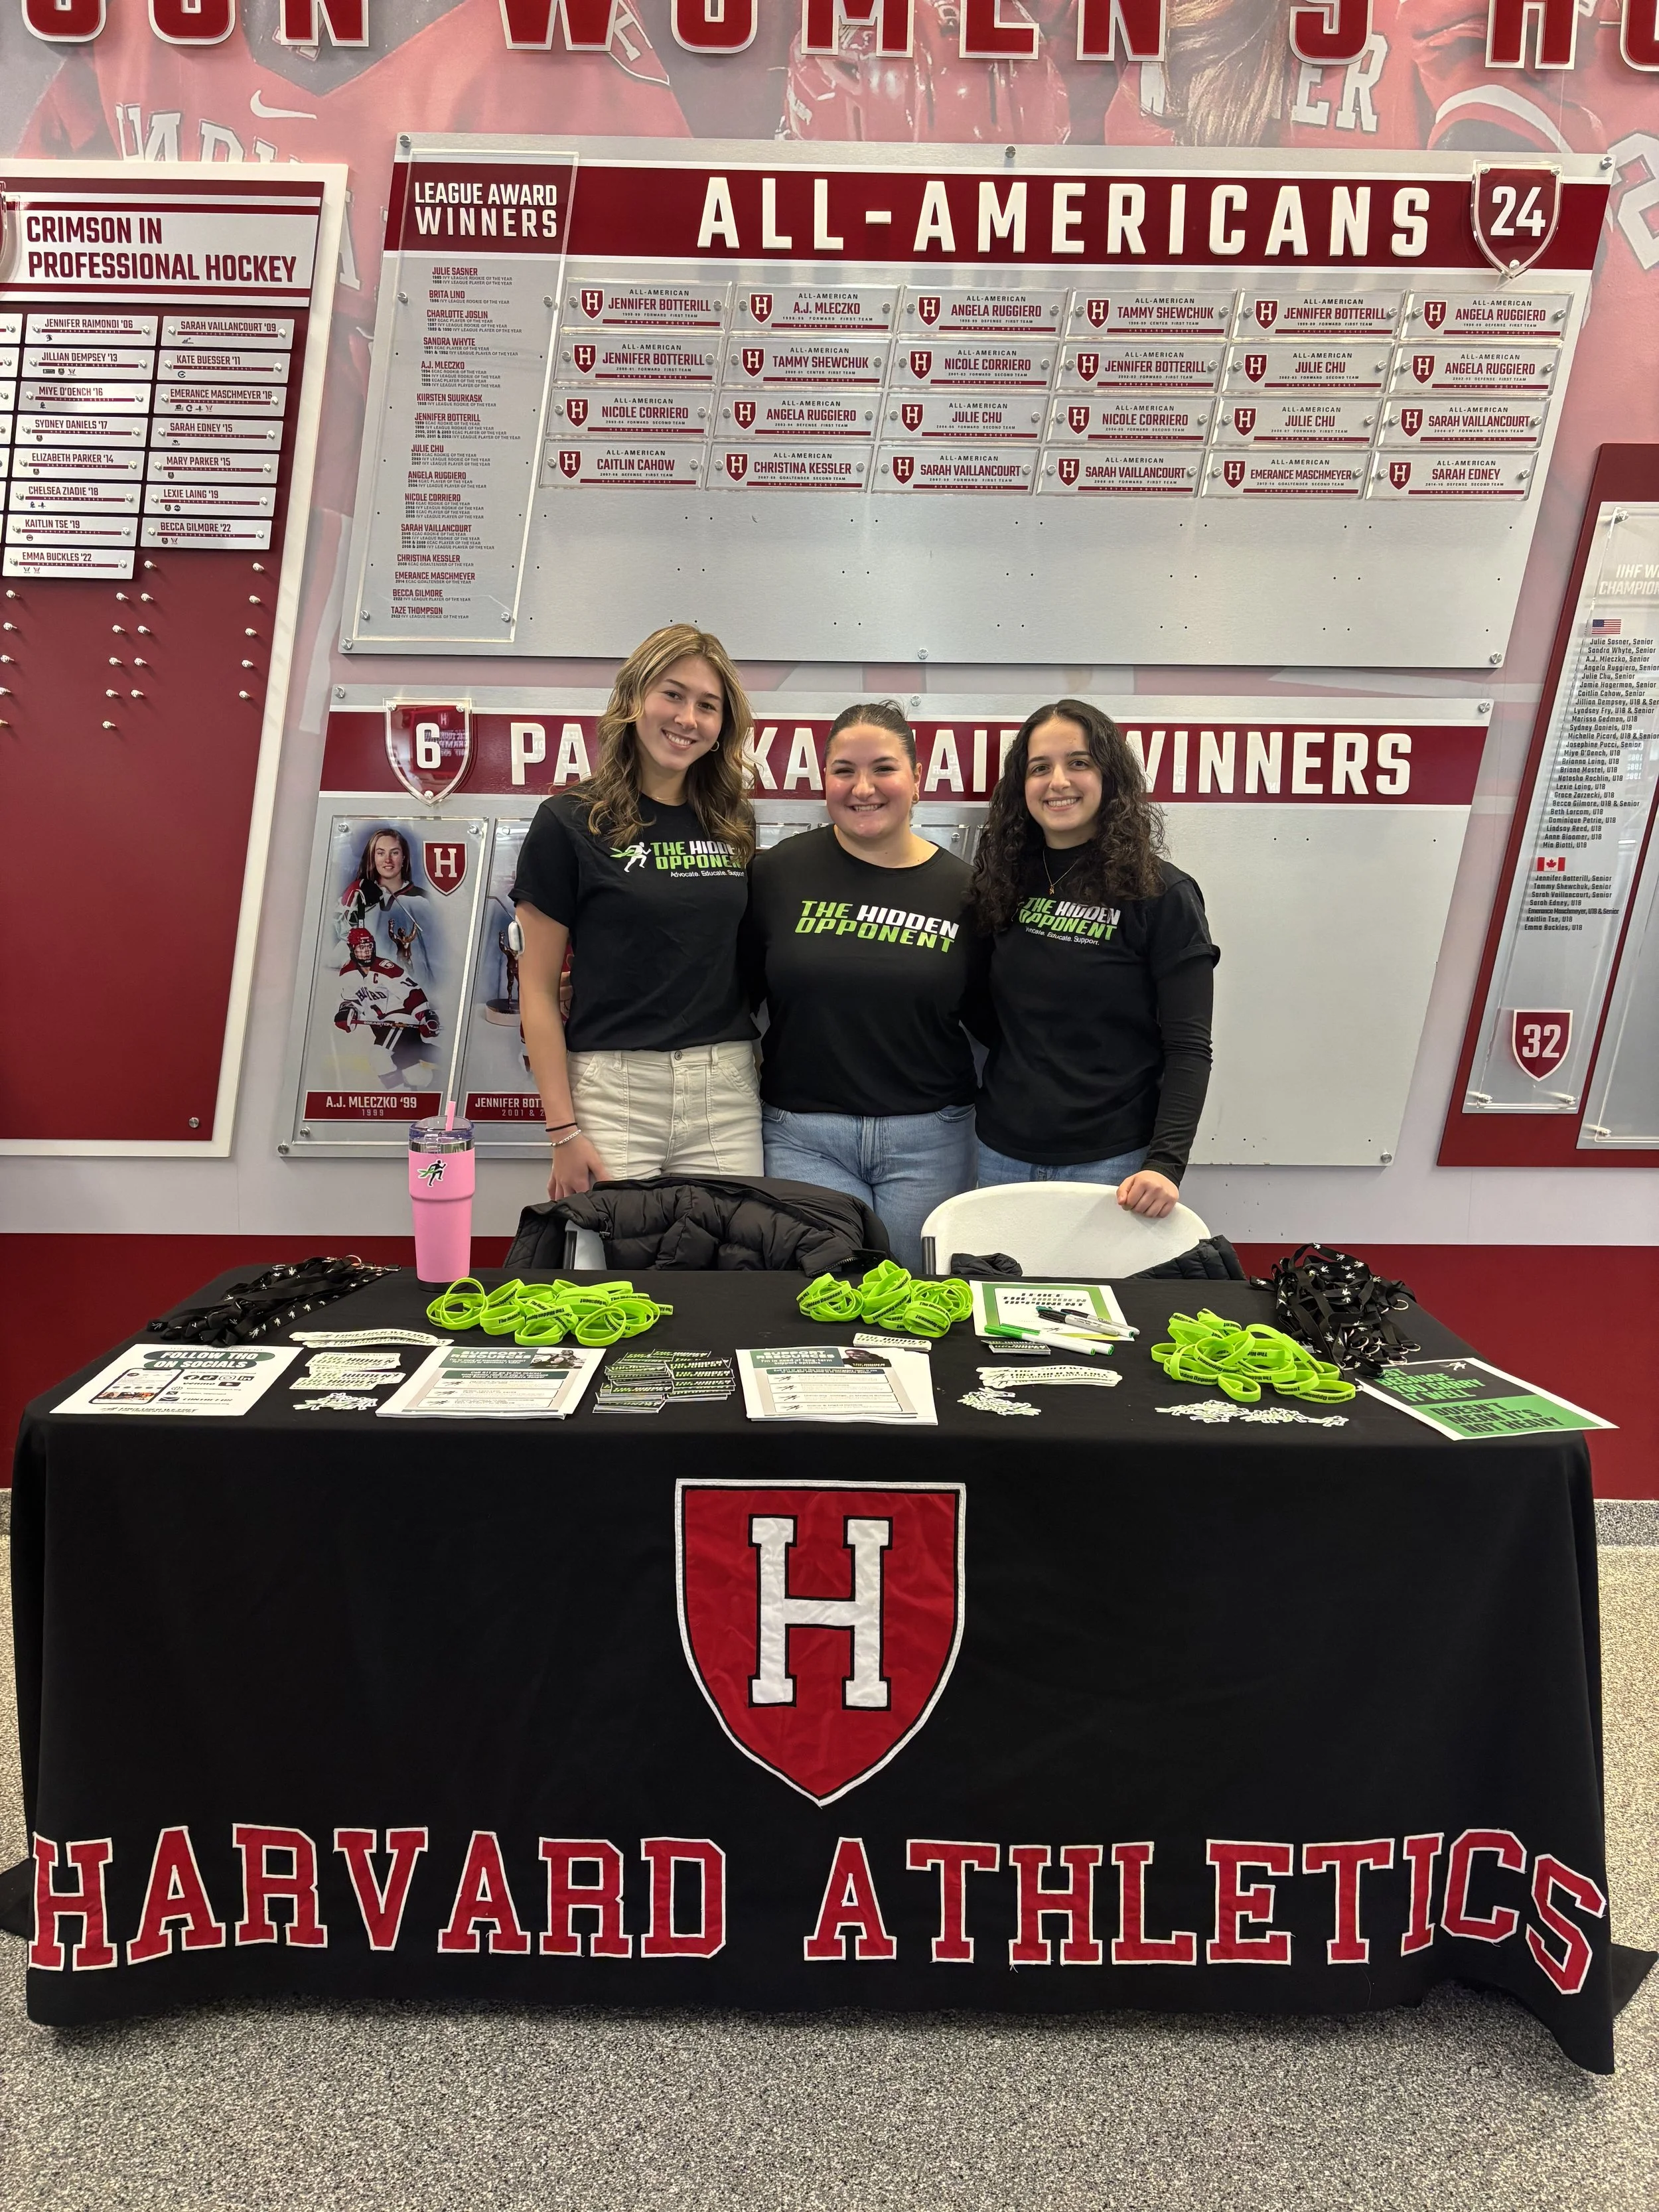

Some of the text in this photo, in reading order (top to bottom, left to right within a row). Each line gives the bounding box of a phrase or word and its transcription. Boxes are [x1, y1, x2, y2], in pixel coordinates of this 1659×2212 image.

[415, 182, 557, 207] LEAGUE AWARD
[697, 177, 1431, 258] ALL-AMERICANS
[1490, 186, 1546, 237] 24
[415, 208, 557, 238] WINNERS
[27, 218, 162, 244] CRIMSON IN
[29, 252, 297, 283] PROFESSIONAL HOCKEY
[609, 298, 711, 311] JENNIFER BOTTERILL
[794, 302, 860, 315] A.J. MLECZKO
[1455, 309, 1546, 321] ANGELA RUGGIERO
[45, 319, 133, 328] JENNIFER RAIMONDI '06
[181, 321, 205, 330] SARAH
[208, 321, 262, 331] VAILLANCOURT
[42, 352, 117, 362] JILLIAN DEMPSEY '13
[177, 355, 194, 364] KATE
[196, 355, 230, 364] BUESSER
[944, 358, 1031, 371] NICOLE CORRIERO
[952, 411, 1002, 423] JULIE CHU
[35, 419, 62, 429] SYDNEY
[64, 420, 97, 429] DANIELS
[597, 459, 675, 471] CAITLIN CAHOW
[754, 462, 851, 475] CHRISTINA KESSLER
[1432, 469, 1500, 481] SARAH EDNEY
[161, 522, 231, 532] BECCA GILMORE '22
[416, 723, 441, 769] 6
[650, 842, 686, 855] THE
[434, 848, 457, 878] H
[1023, 897, 1121, 925] THE HIDDEN
[802, 901, 960, 939] THE HIDDEN
[1019, 909, 1117, 940] OPPONENT
[795, 917, 954, 952] OPPONENT
[1047, 932, 1099, 945] Educate. Support.
[1522, 1024, 1561, 1058] 32
[326, 1096, 346, 1108] A.J.
[348, 1096, 397, 1108] MLECZKO
[475, 1097, 520, 1108] JENNIFER
[1374, 1372, 1455, 1386] BECAUSE
[1425, 1378, 1486, 1391] CARRY
[1425, 1390, 1476, 1400] WELL
[1429, 1402, 1508, 1416] DOESN'T
[1443, 1409, 1543, 1424] MEAN IT'S
[1459, 1417, 1564, 1433] NOT HEAVY
[749, 1514, 893, 1710] H
[28, 1823, 1605, 1995] HARVARD ATHLETICS
